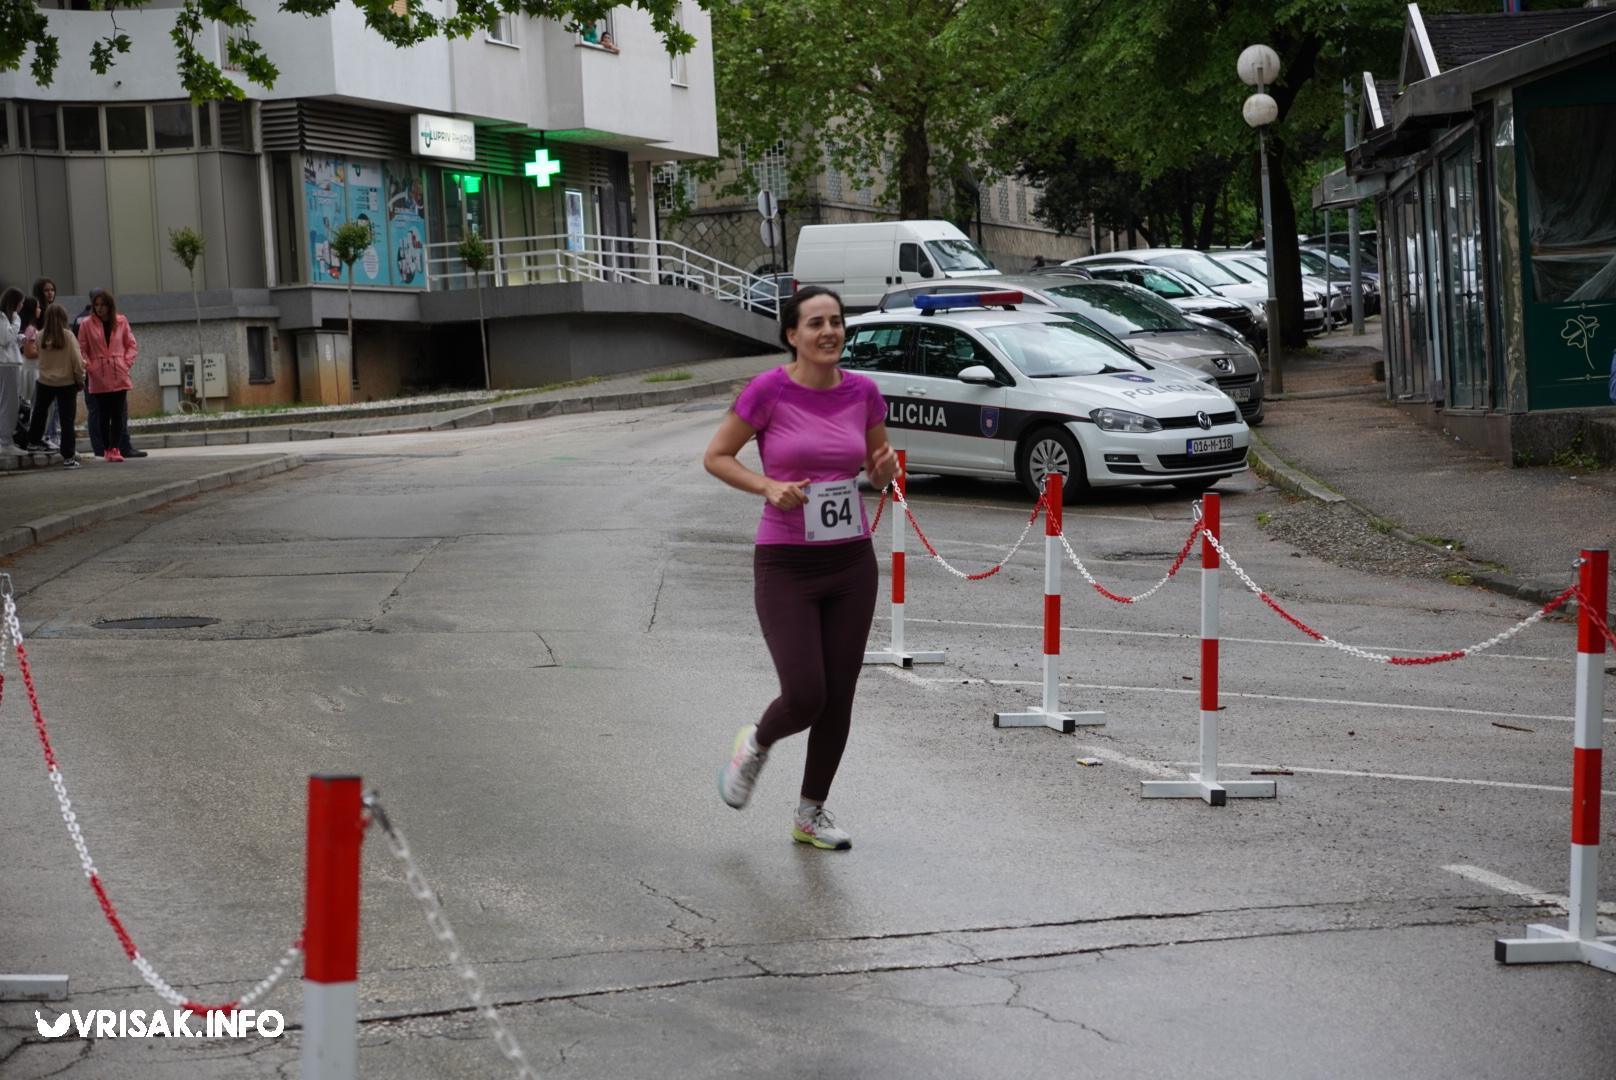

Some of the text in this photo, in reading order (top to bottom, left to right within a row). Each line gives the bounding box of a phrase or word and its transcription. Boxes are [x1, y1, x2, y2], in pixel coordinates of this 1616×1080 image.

[1122, 384, 1214, 399] POLICIJA
[885, 402, 947, 427] LICIJA
[821, 498, 852, 528] 64
